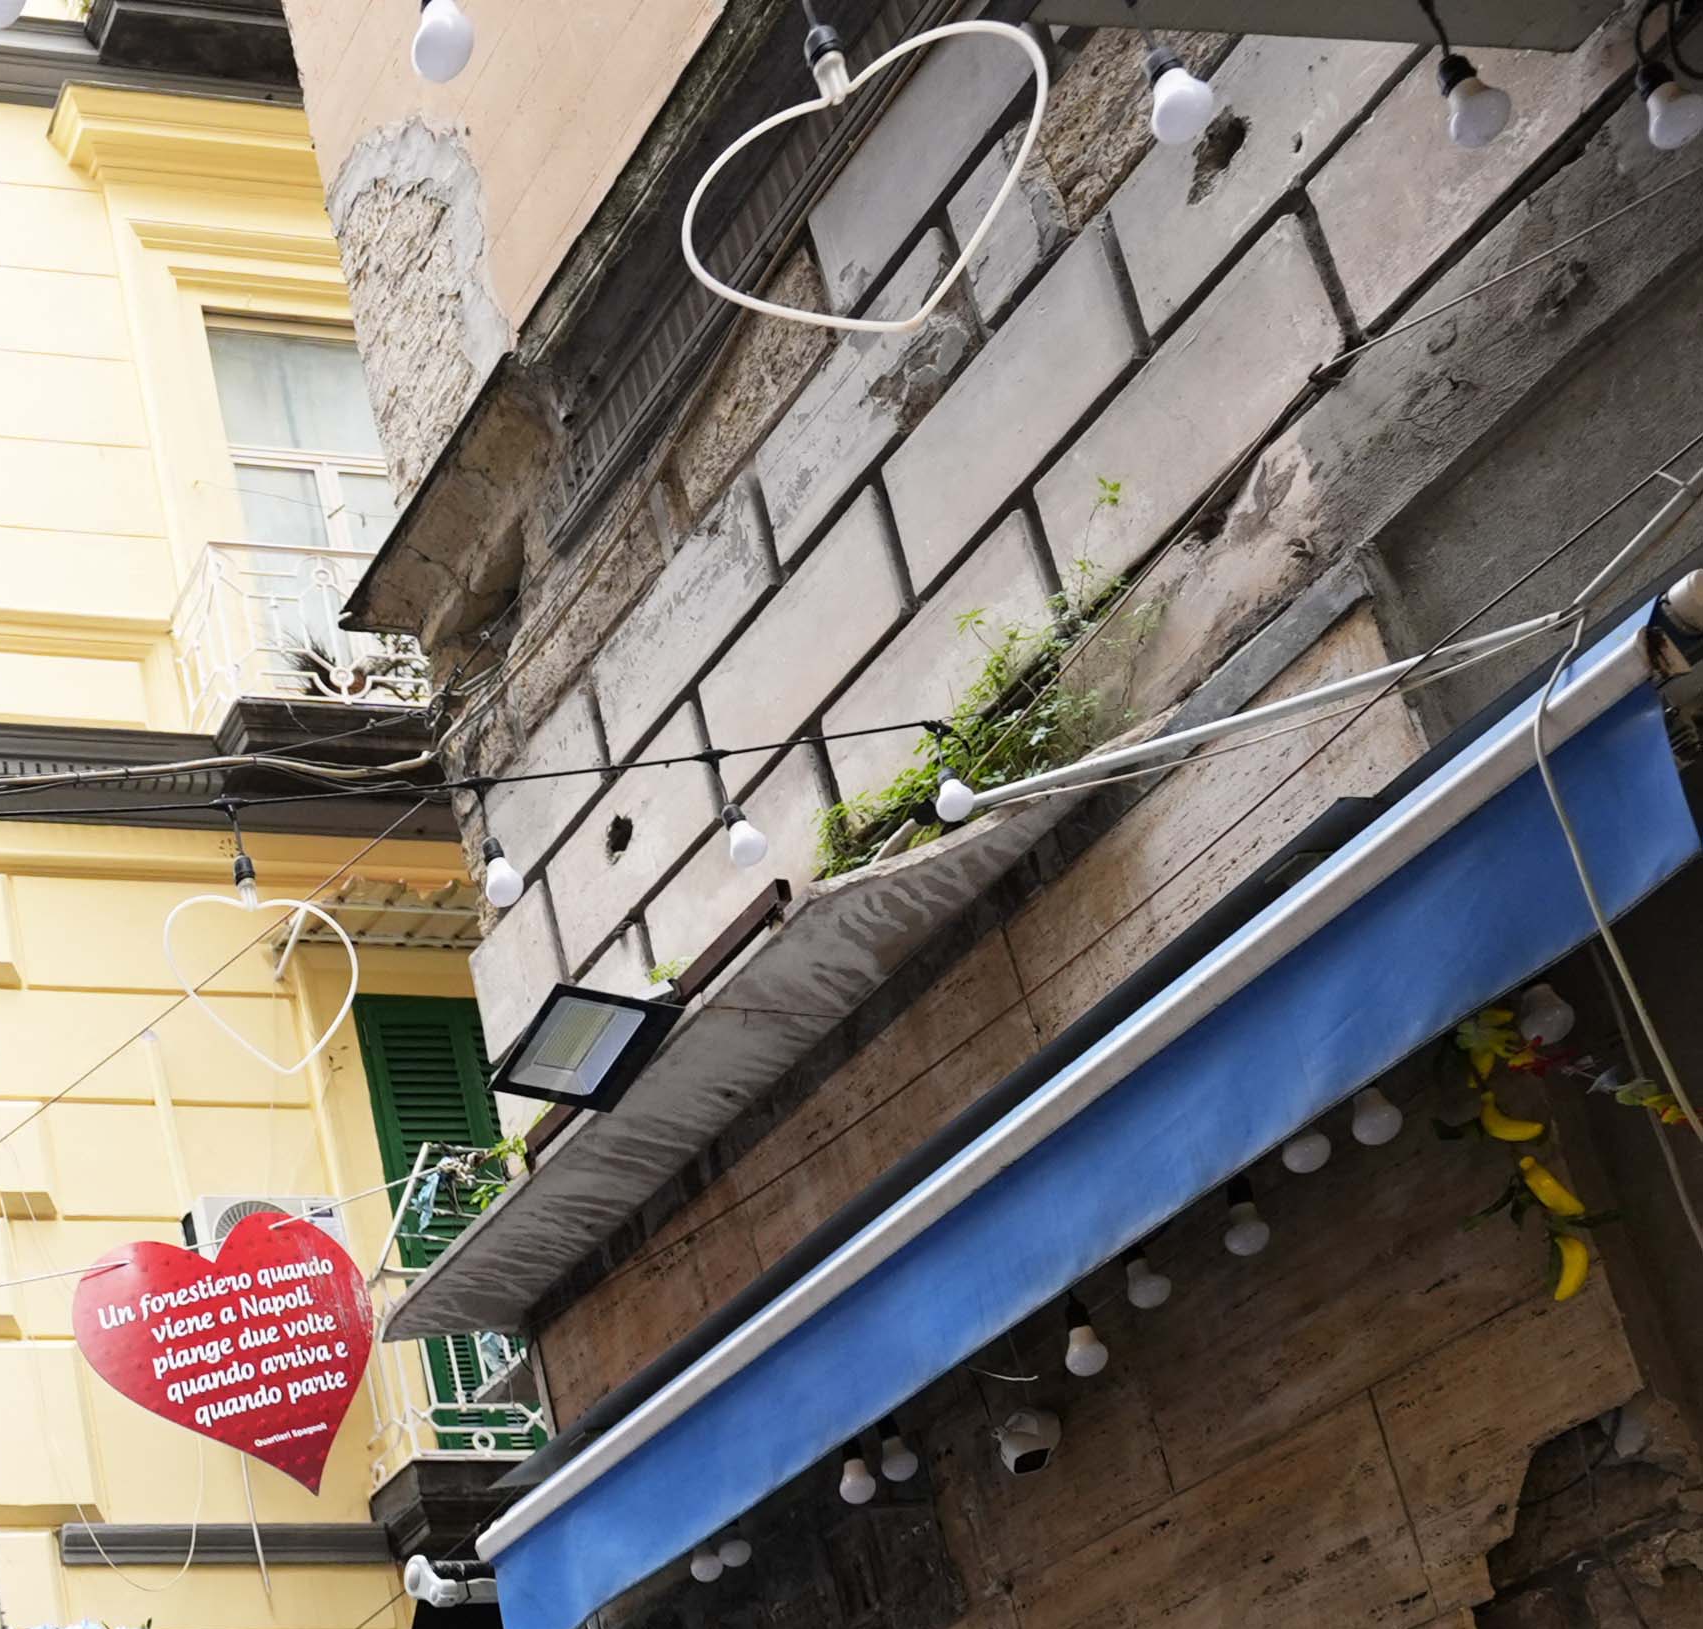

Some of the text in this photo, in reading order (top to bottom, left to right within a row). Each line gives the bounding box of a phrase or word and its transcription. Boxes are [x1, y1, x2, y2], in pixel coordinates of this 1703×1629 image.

[98, 1256, 334, 1329] Un forestiero quando
[152, 1284, 313, 1343] viene a Napoli
[152, 1313, 336, 1379] piange due volte
[167, 1341, 349, 1404] quando arriva e
[195, 1371, 348, 1427] quando parte
[254, 1422, 328, 1448] Quartieri Spagnoli
